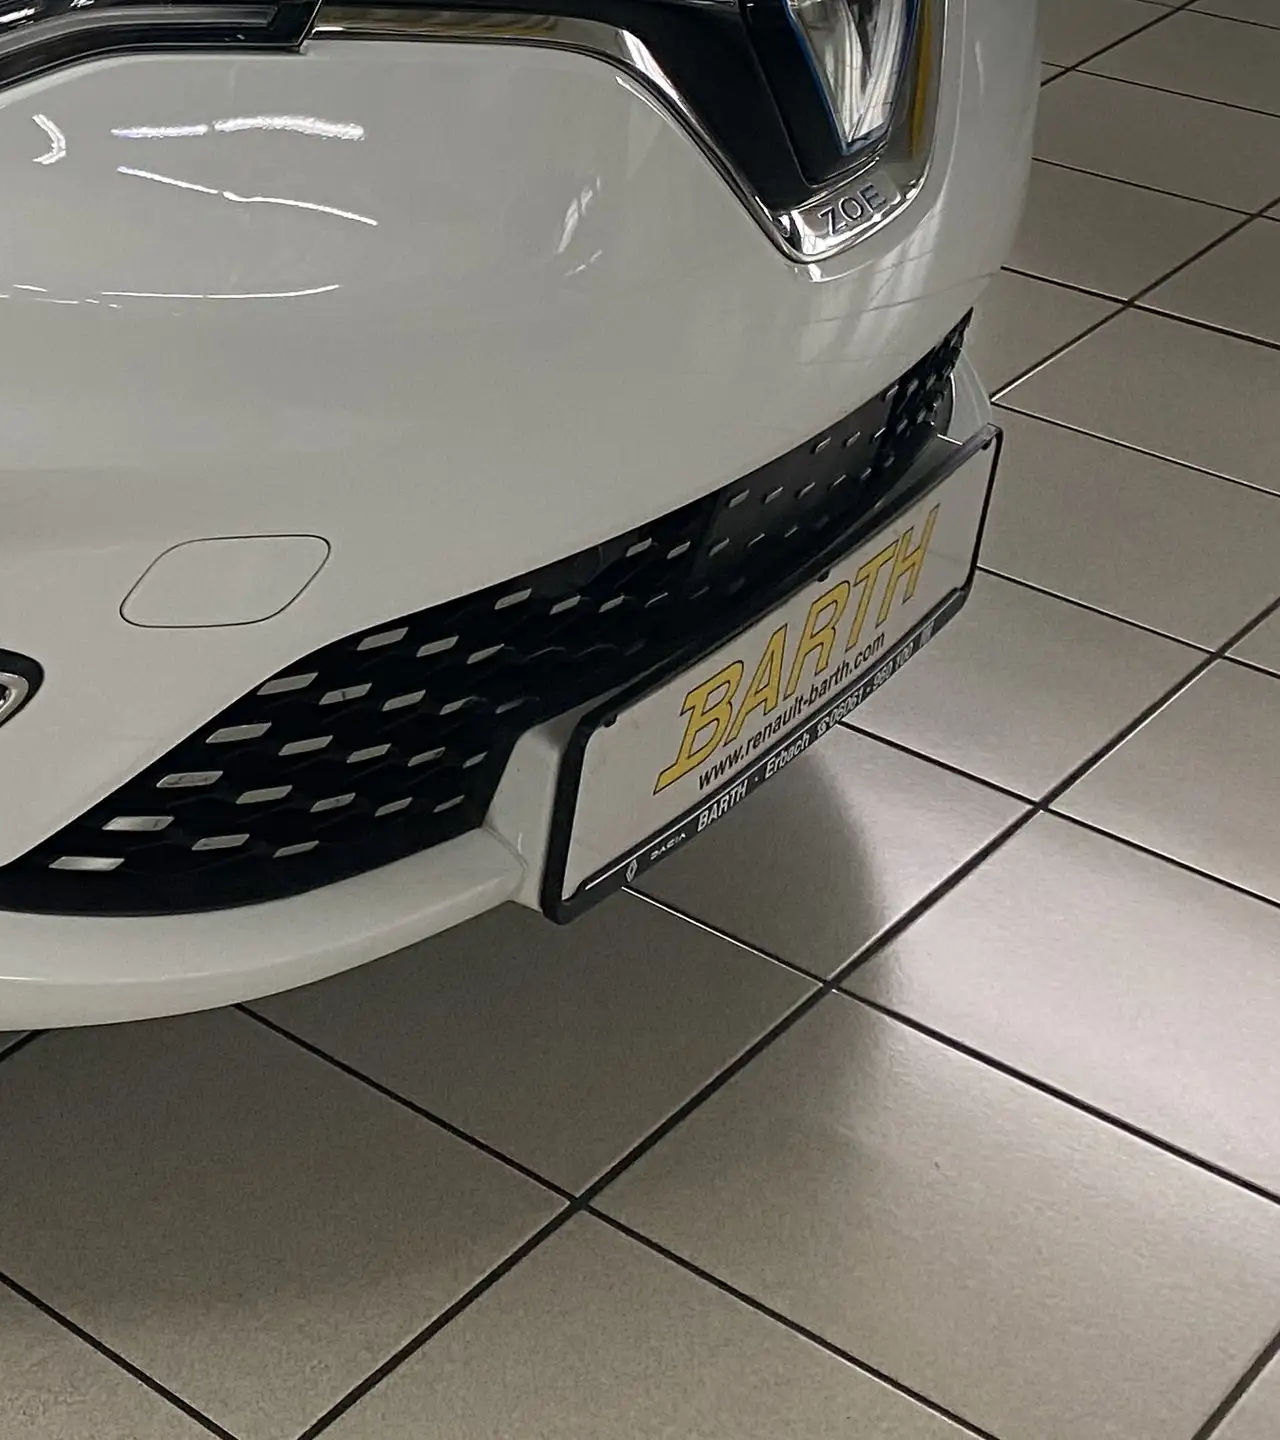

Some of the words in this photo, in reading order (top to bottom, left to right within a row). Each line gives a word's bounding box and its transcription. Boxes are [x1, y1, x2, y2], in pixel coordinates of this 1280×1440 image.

[818, 182, 887, 237] ZOE
[653, 502, 941, 795] BARTH
[698, 632, 885, 790] www.renault-barth.com
[697, 780, 748, 832] BARTH
[764, 733, 811, 779] Erbach
